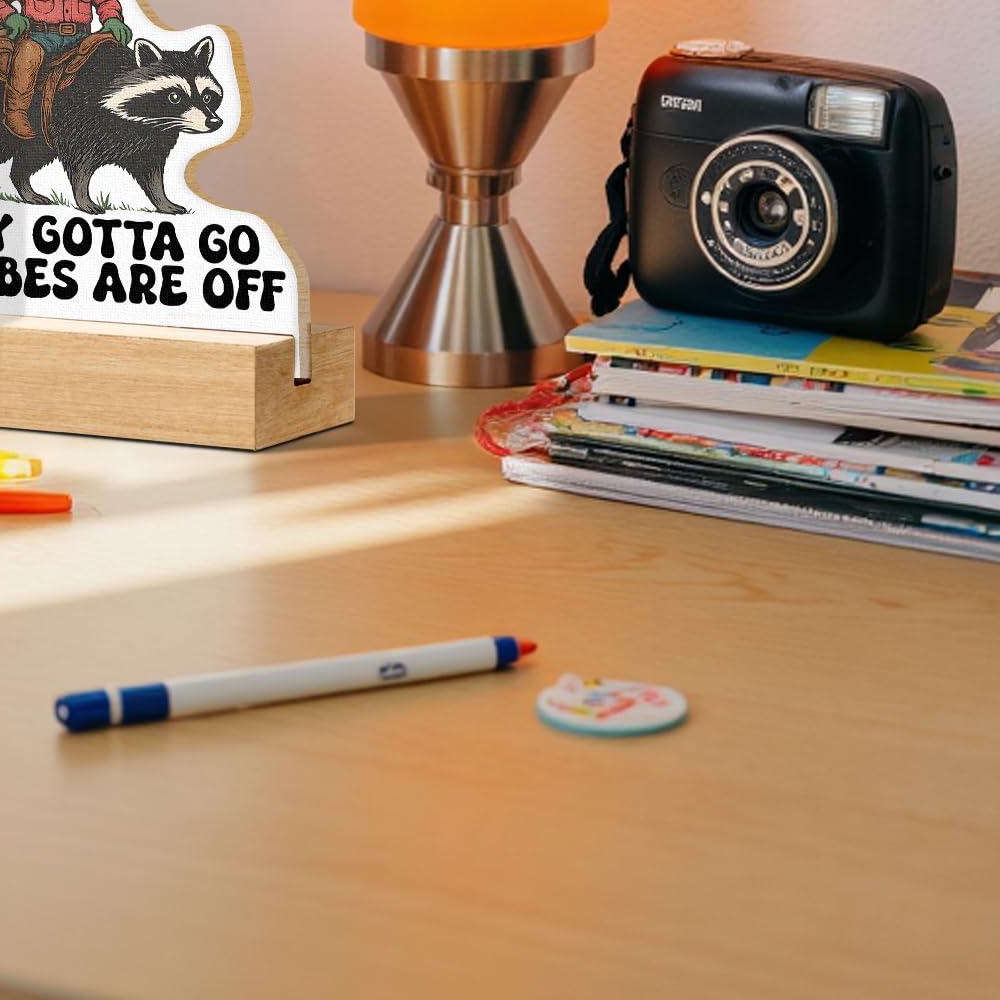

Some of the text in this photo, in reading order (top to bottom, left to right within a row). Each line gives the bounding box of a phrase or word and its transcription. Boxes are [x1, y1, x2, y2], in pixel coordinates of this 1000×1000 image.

[32, 215, 185, 262] GOTTA
[198, 223, 260, 266] GO
[92, 261, 188, 307] ARE
[202, 267, 286, 312] OFF
